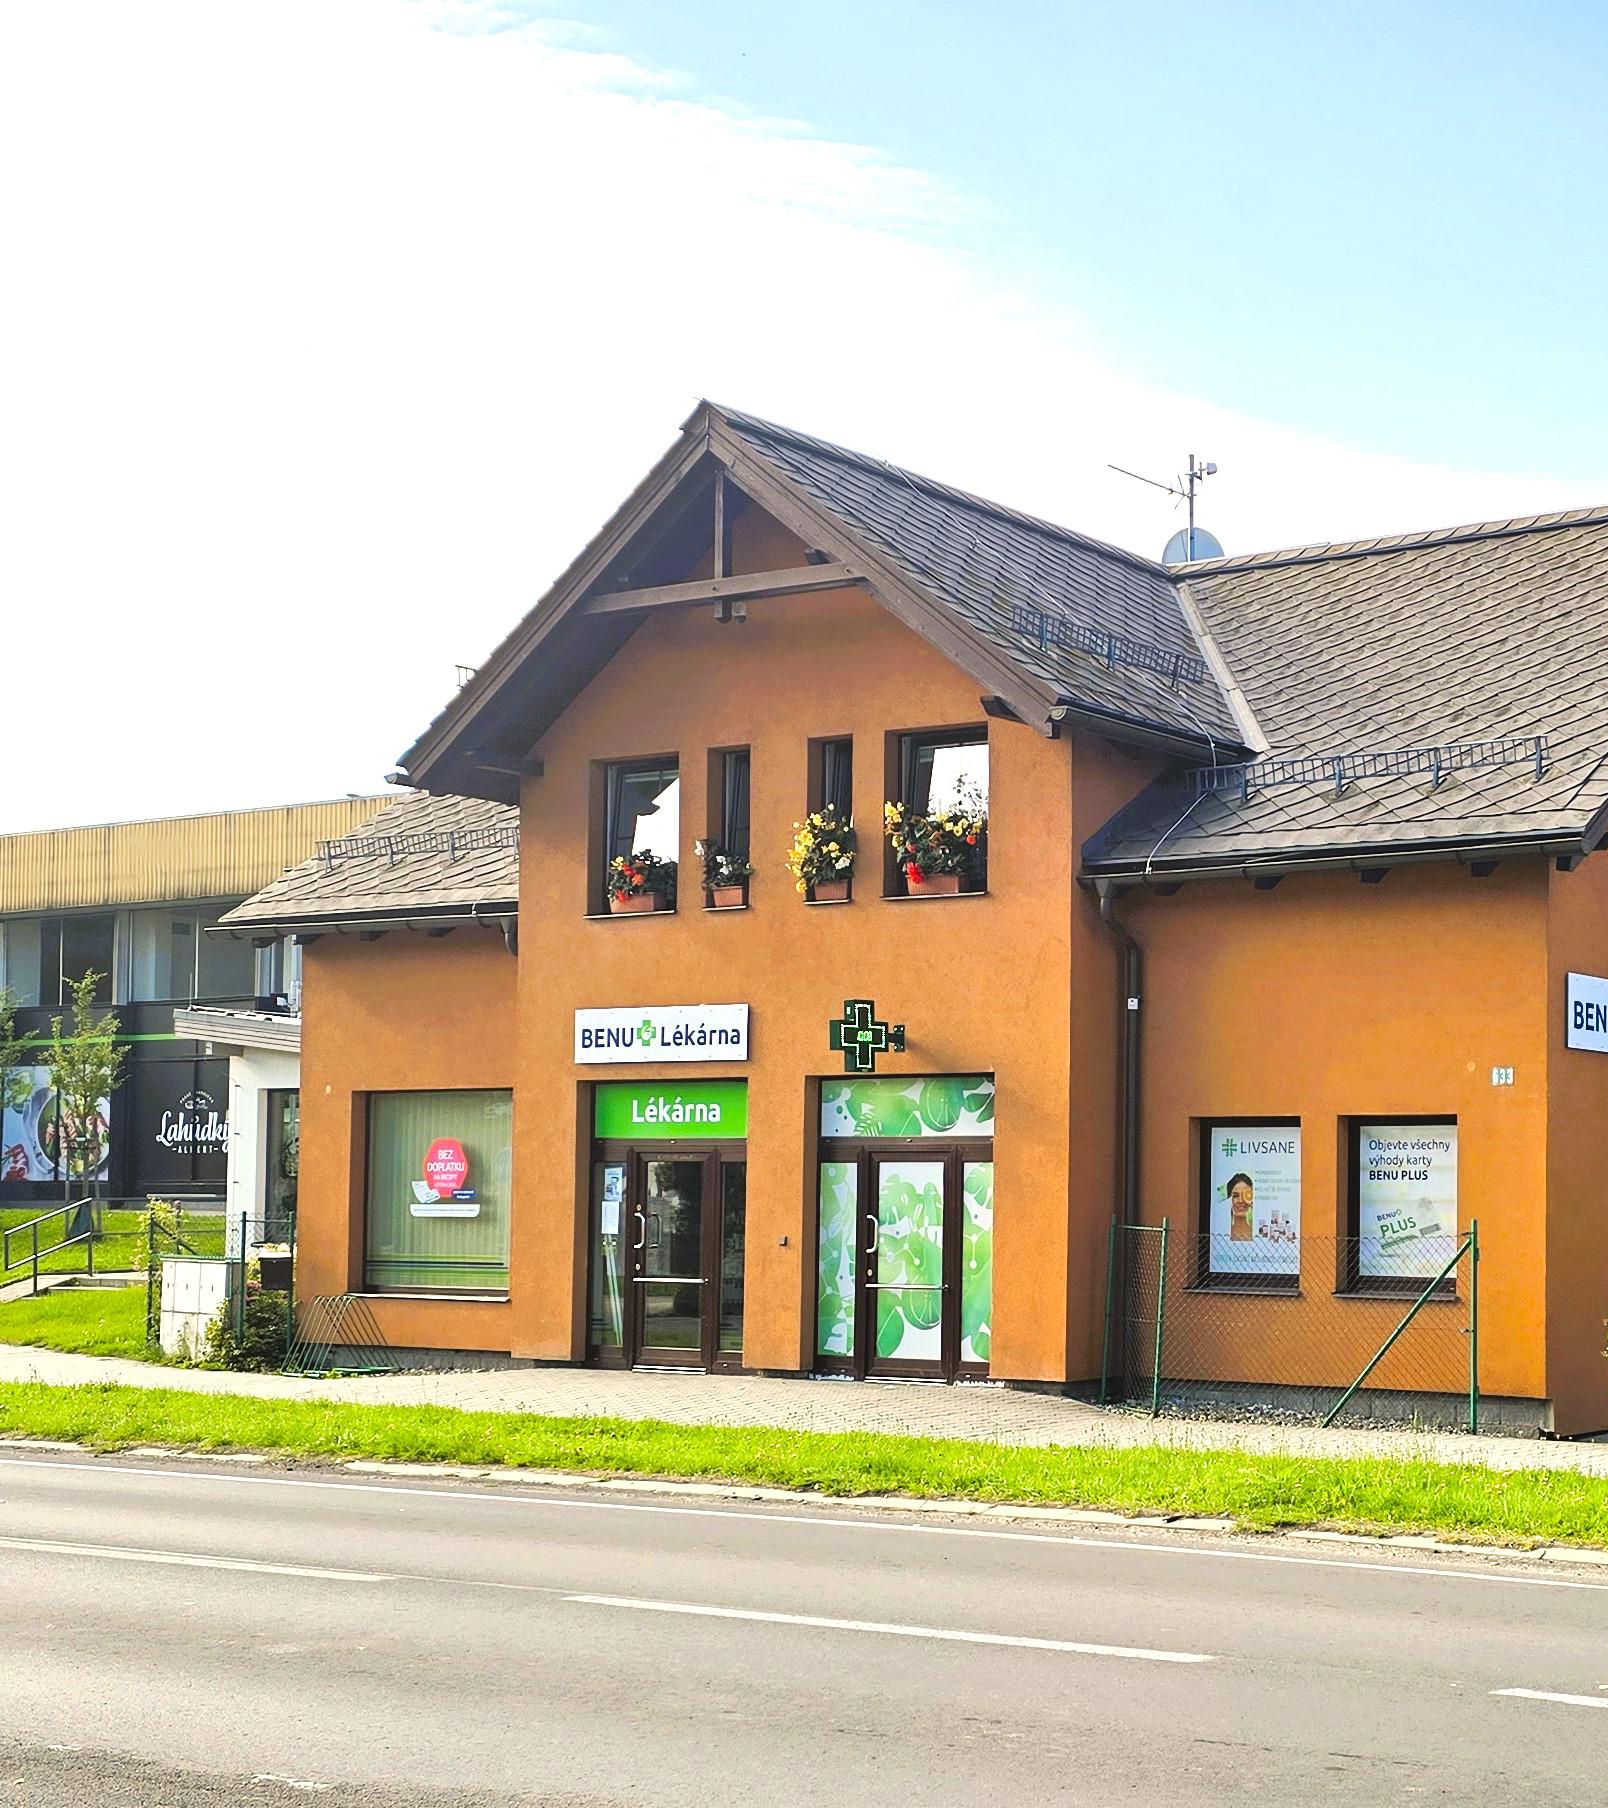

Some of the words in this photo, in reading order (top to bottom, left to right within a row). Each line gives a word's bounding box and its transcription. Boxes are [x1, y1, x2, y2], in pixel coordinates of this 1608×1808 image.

[581, 1027, 634, 1048] BENU
[660, 1023, 741, 1047] Lékárna
[632, 1096, 721, 1123] Lékárna
[1240, 1141, 1295, 1154] LIVSANE
[1368, 1139, 1408, 1152] Objevte
[1410, 1138, 1450, 1152] všechny
[437, 1149, 454, 1160] BEZ
[1368, 1154, 1404, 1168] výhody
[1406, 1154, 1432, 1168] karty
[426, 1161, 465, 1172] DOPLATKU
[1369, 1170, 1398, 1181] BENU
[1401, 1170, 1428, 1181] PLUS
[1376, 1211, 1396, 1222] BENU
[1380, 1216, 1417, 1238] PLUS
